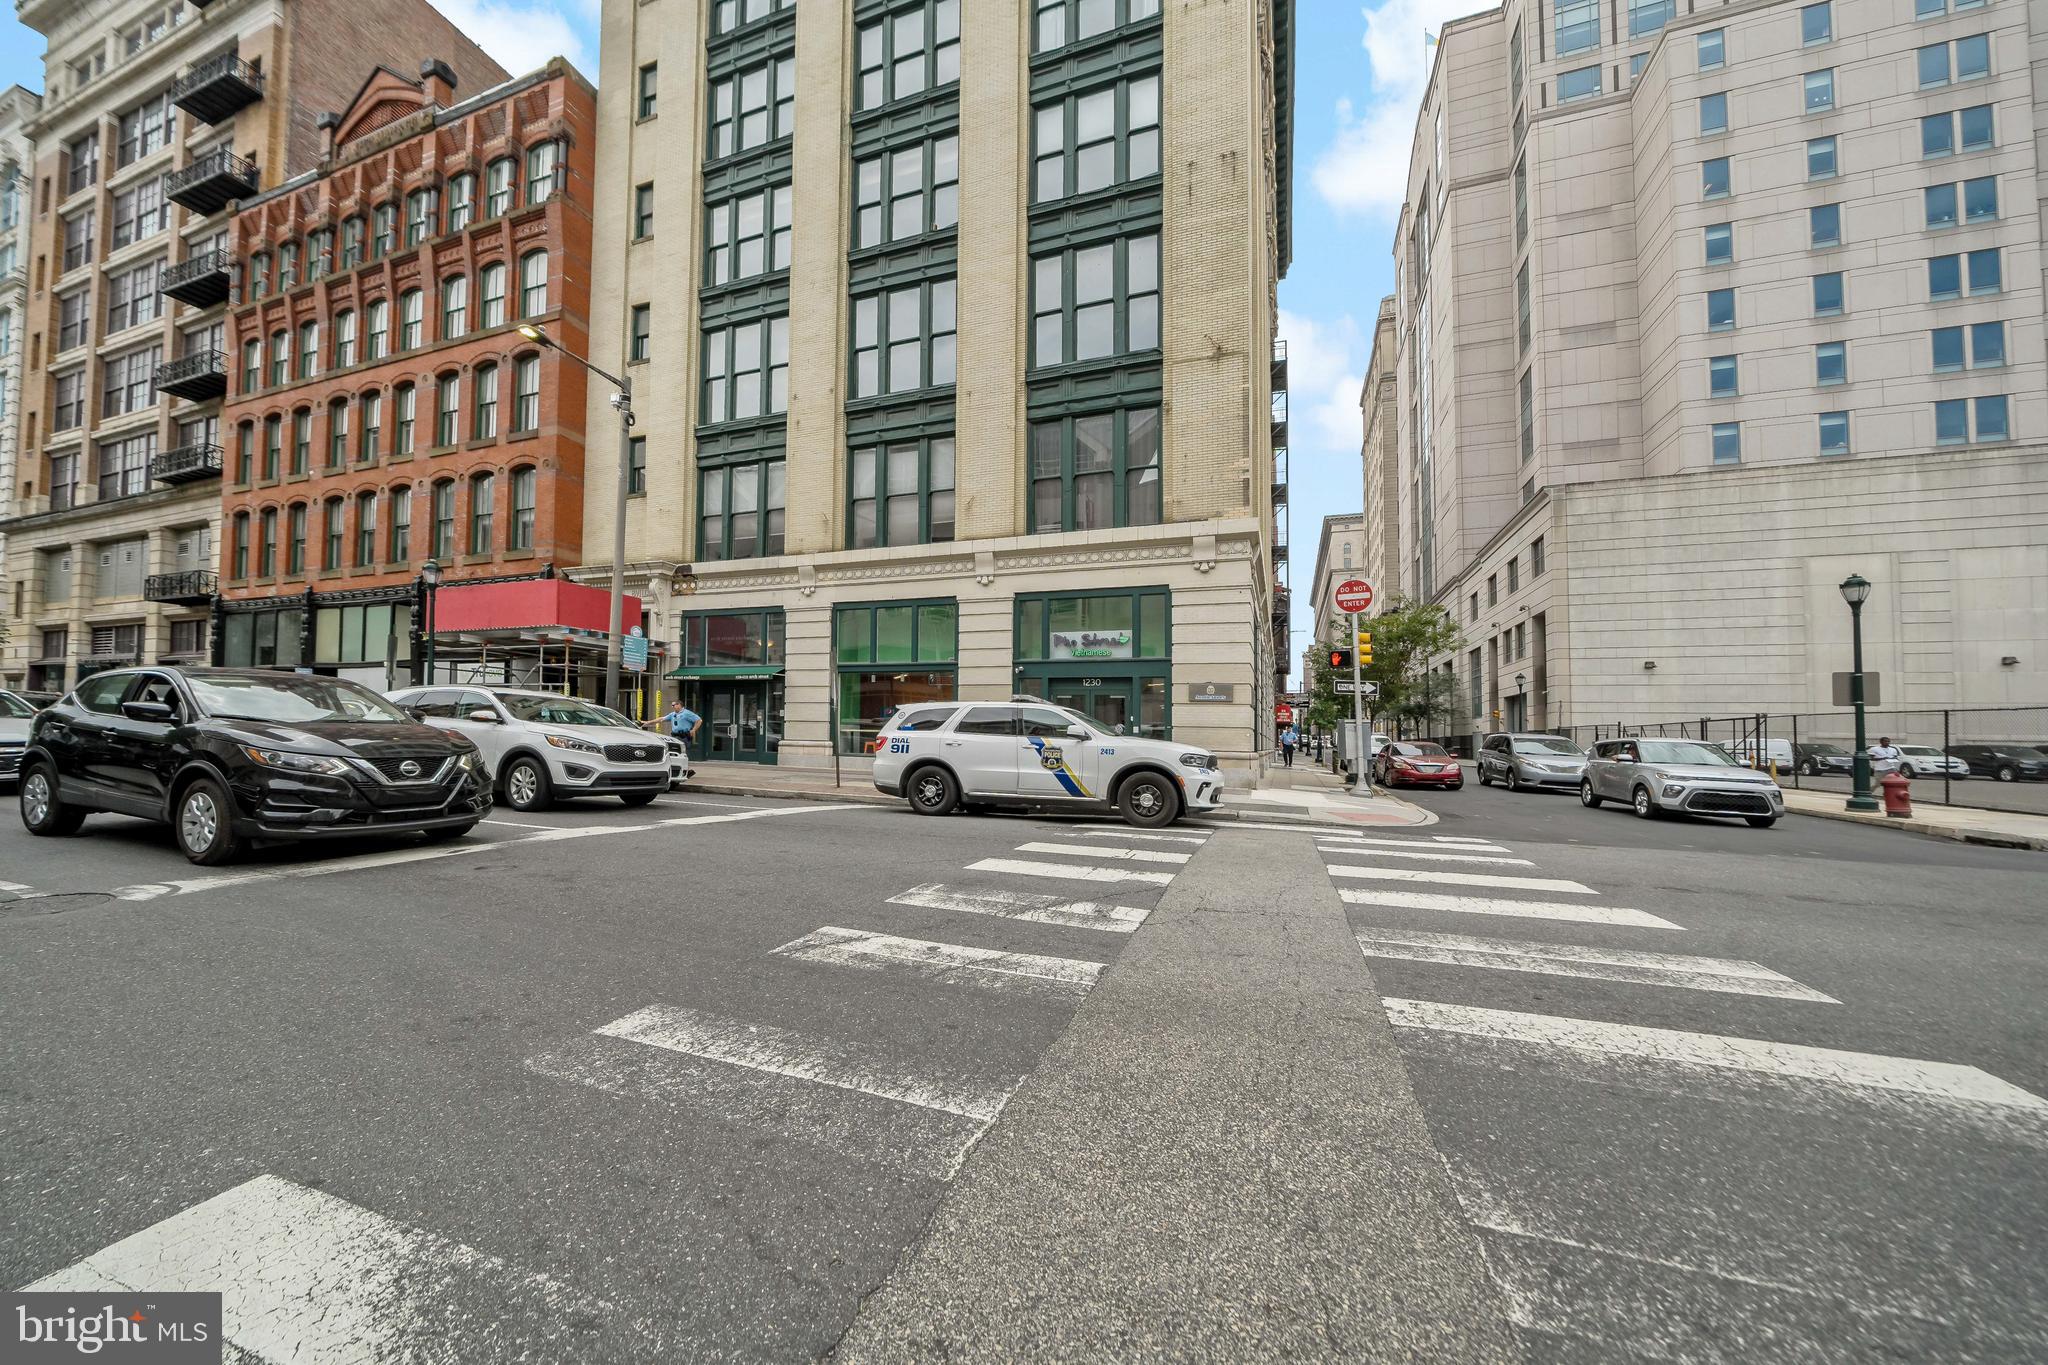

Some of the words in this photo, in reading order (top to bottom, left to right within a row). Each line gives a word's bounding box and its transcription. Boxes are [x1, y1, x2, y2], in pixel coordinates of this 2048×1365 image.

[1053, 633, 1078, 648] Pho
[1082, 678, 1102, 687] 1230
[890, 744, 910, 754] 911
[1100, 747, 1115, 755] 2413
